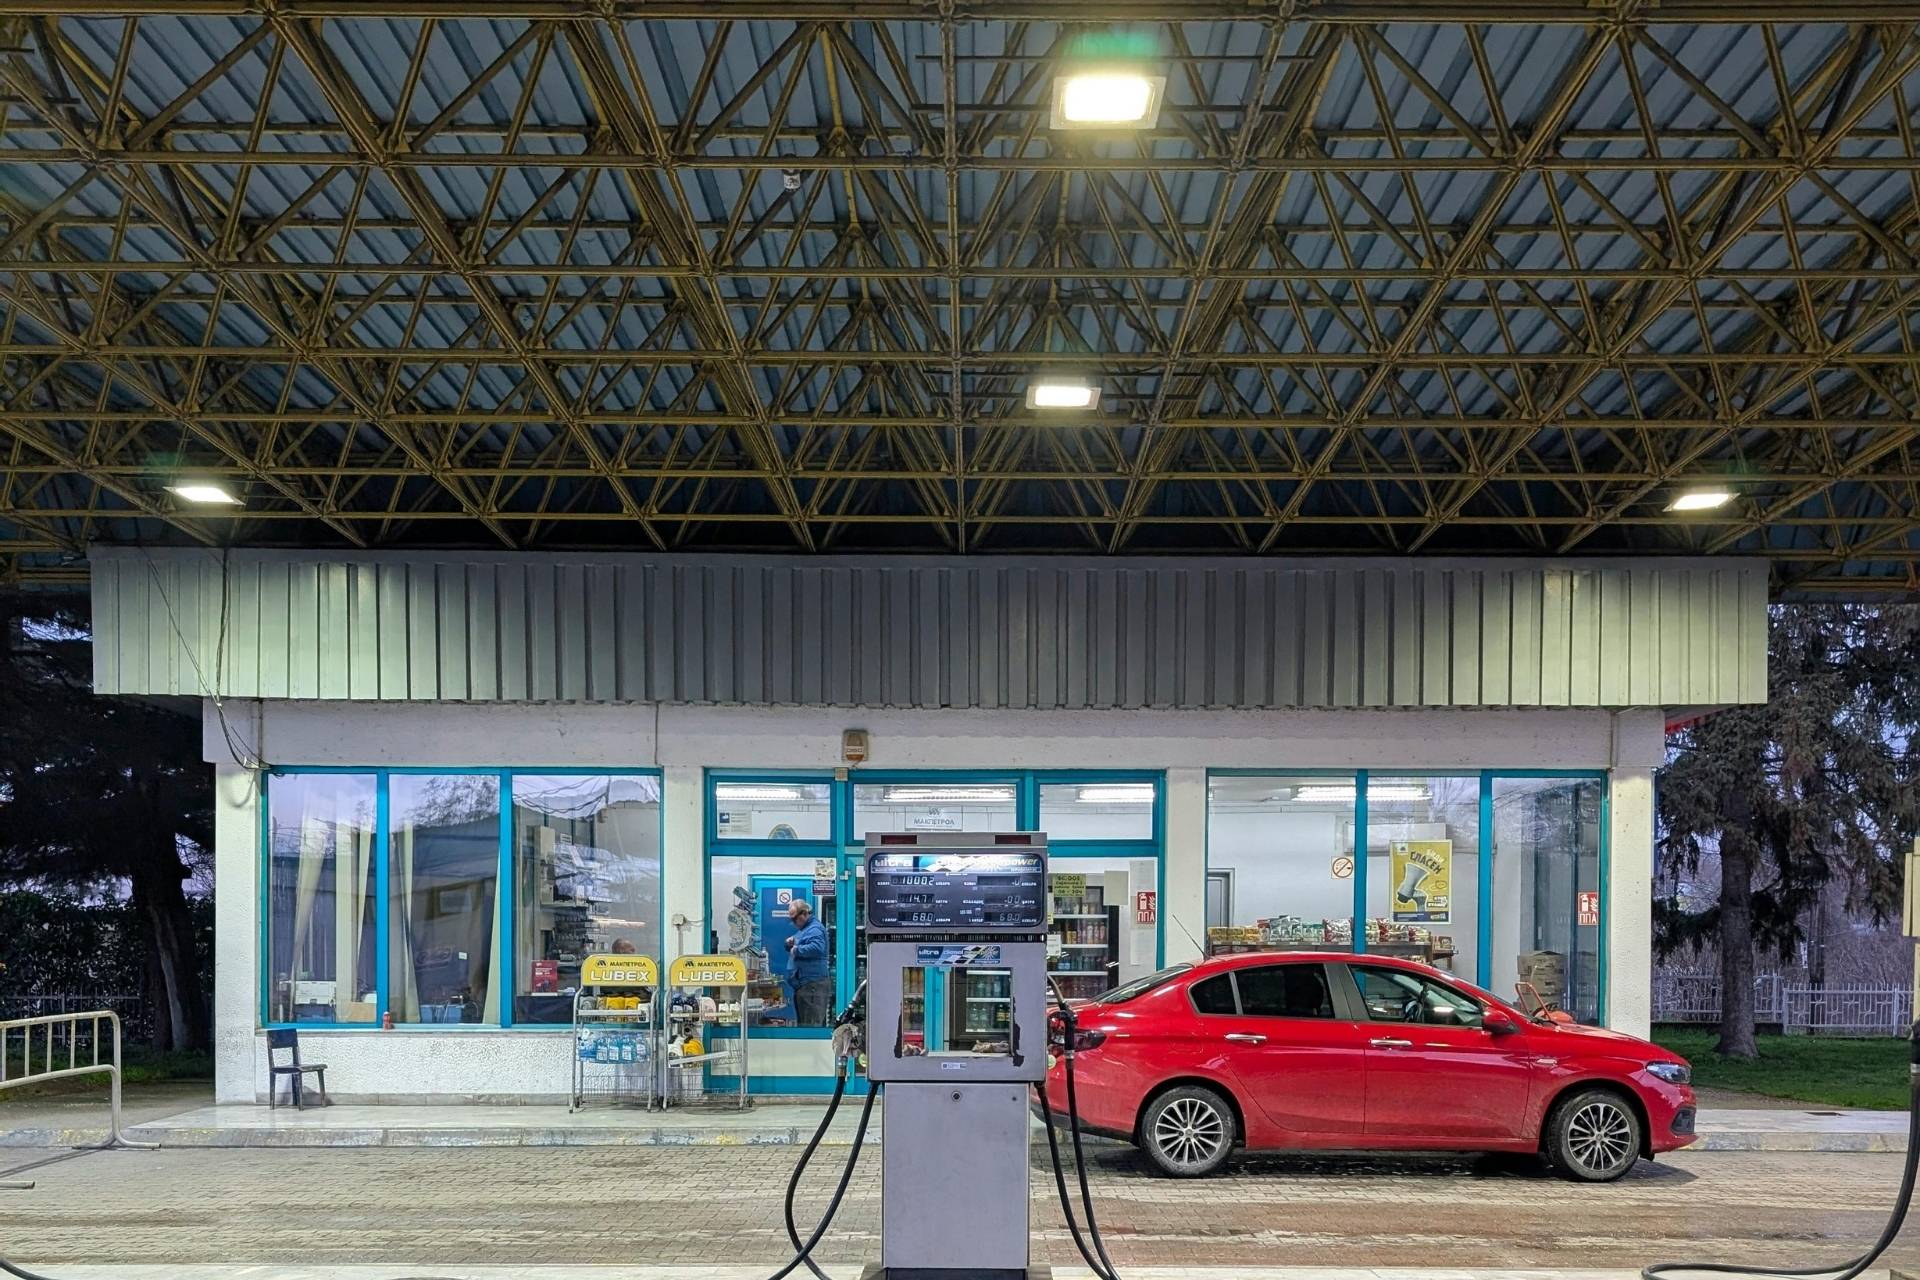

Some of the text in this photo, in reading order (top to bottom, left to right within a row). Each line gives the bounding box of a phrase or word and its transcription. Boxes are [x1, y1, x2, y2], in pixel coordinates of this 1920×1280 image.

[1410, 851, 1442, 874] СПАСЕН
[1137, 911, 1155, 922] ППА
[1579, 913, 1597, 924] ППА
[590, 970, 649, 981] LUBEX
[679, 970, 737, 981] LUBEX
